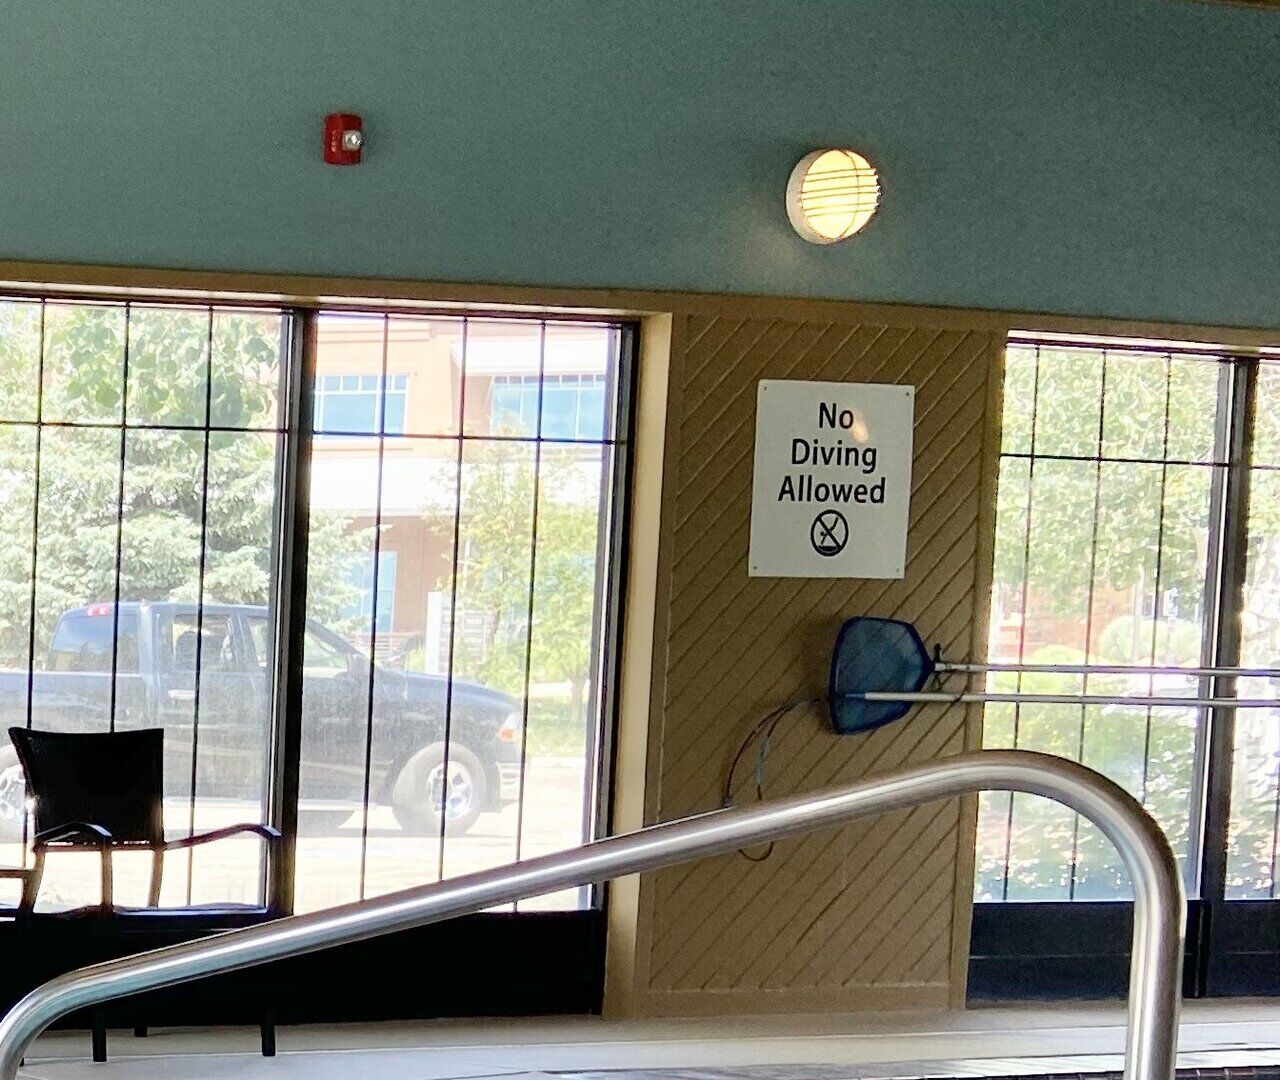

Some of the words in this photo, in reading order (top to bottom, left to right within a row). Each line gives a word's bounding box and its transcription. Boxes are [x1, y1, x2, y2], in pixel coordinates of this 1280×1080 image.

[819, 402, 854, 429] No
[791, 438, 877, 474] Diving
[777, 475, 886, 504] Allowed
